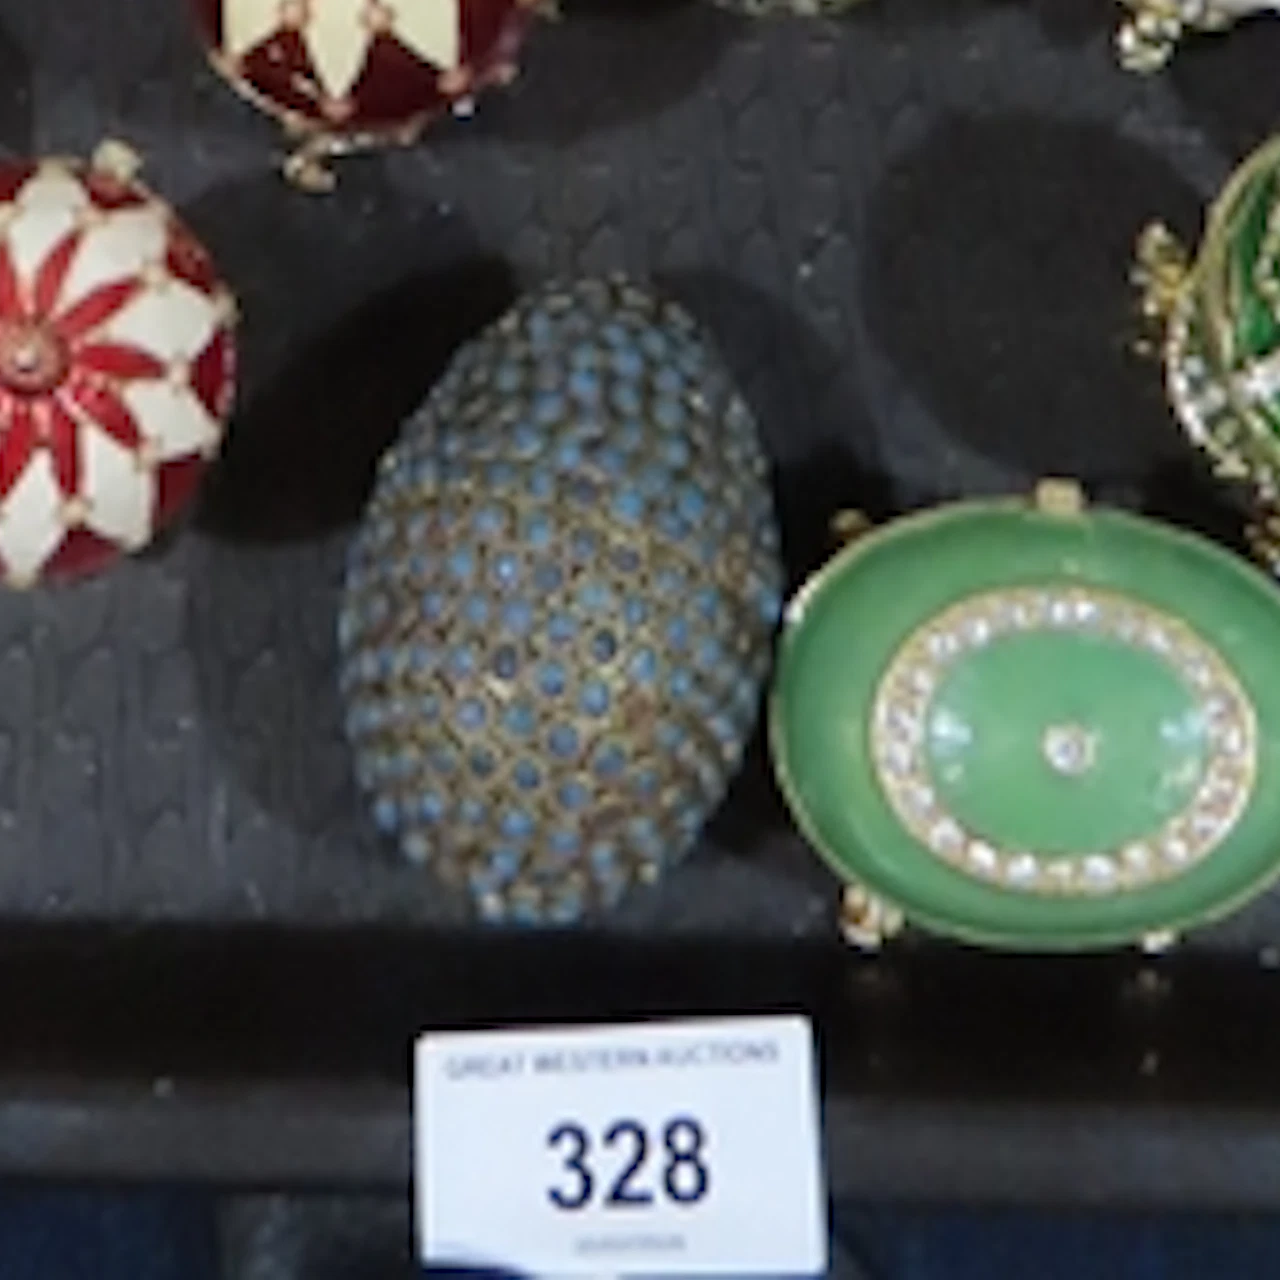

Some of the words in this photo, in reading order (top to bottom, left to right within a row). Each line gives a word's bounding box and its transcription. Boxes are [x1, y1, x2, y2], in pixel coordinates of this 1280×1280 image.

[445, 1049, 525, 1080] GREAT
[534, 1042, 649, 1075] WESTERN
[656, 1037, 780, 1069] AUCTIONS
[546, 1112, 710, 1210] 328
